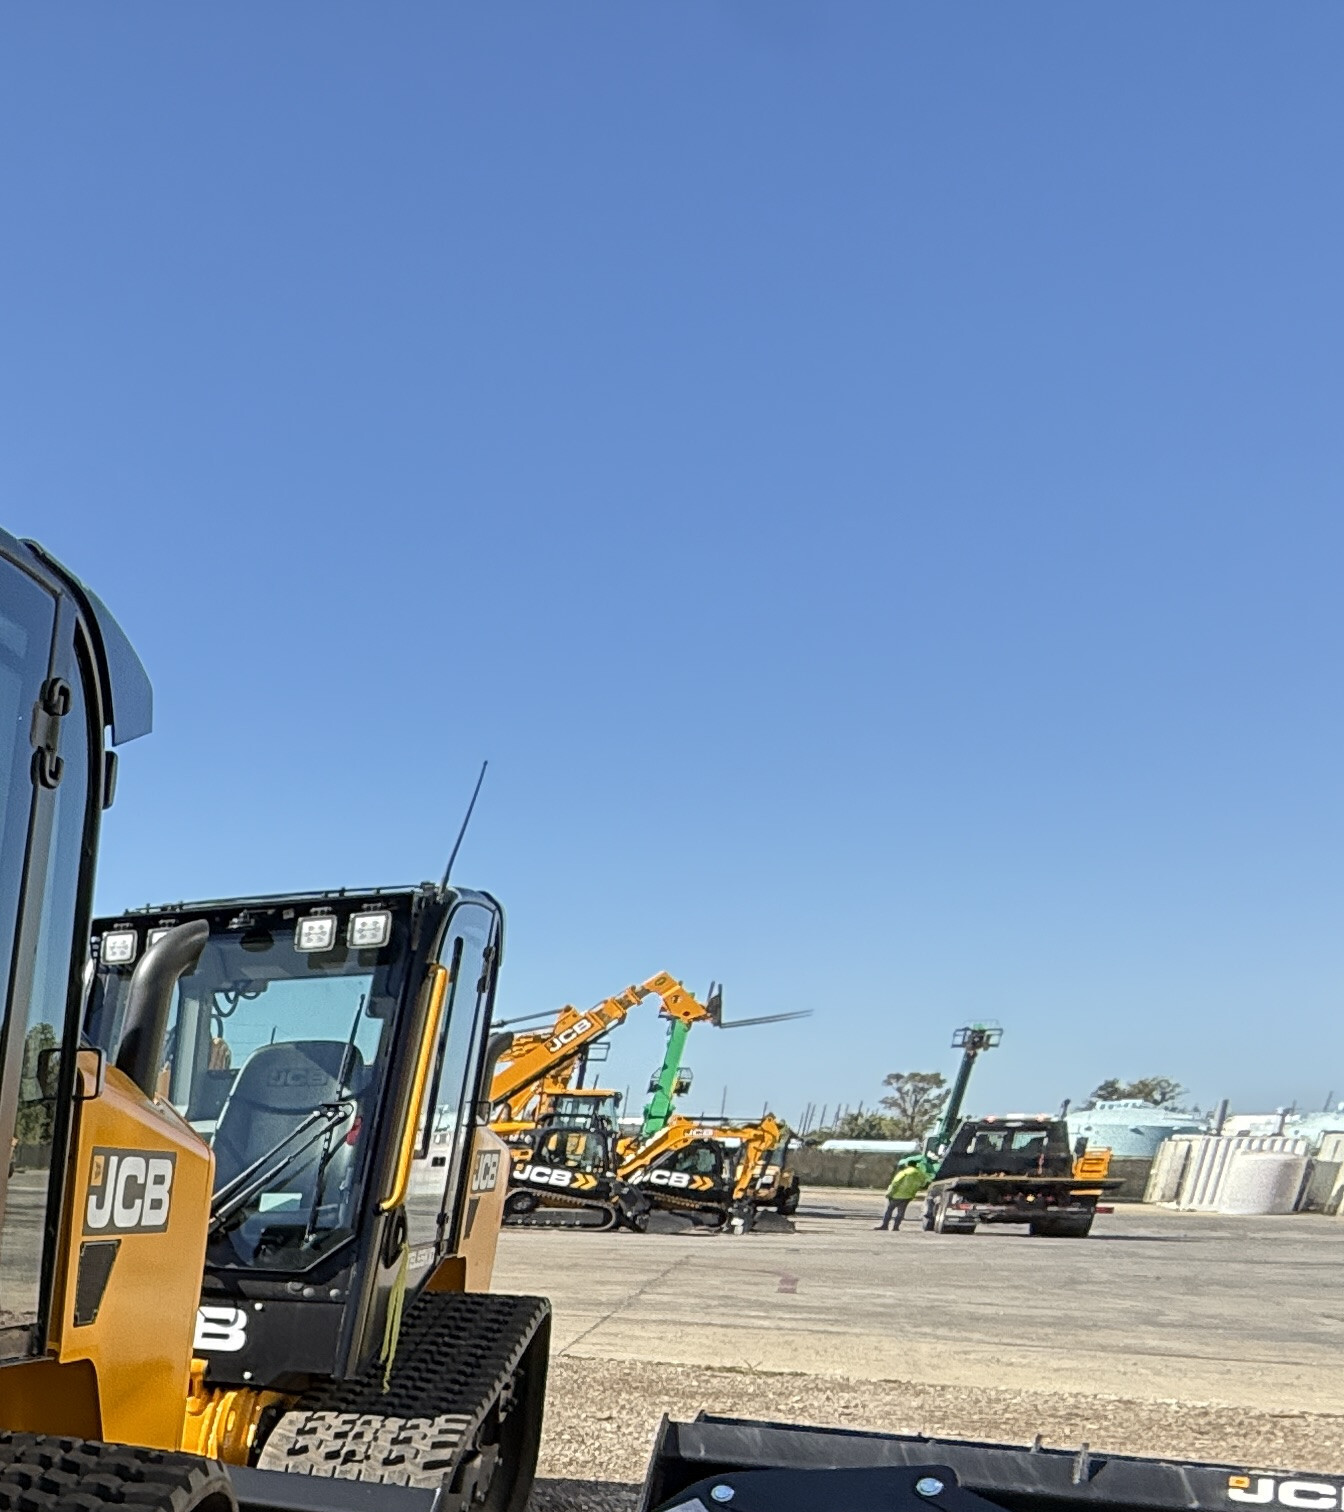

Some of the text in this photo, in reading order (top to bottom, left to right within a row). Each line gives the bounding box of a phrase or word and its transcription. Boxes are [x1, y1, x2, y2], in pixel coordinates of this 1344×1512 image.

[549, 1018, 592, 1053] JCB
[472, 1152, 499, 1191] JCB
[513, 1163, 572, 1188] JCB
[87, 1156, 173, 1229] JCB
[1228, 1478, 1344, 1512] JC
